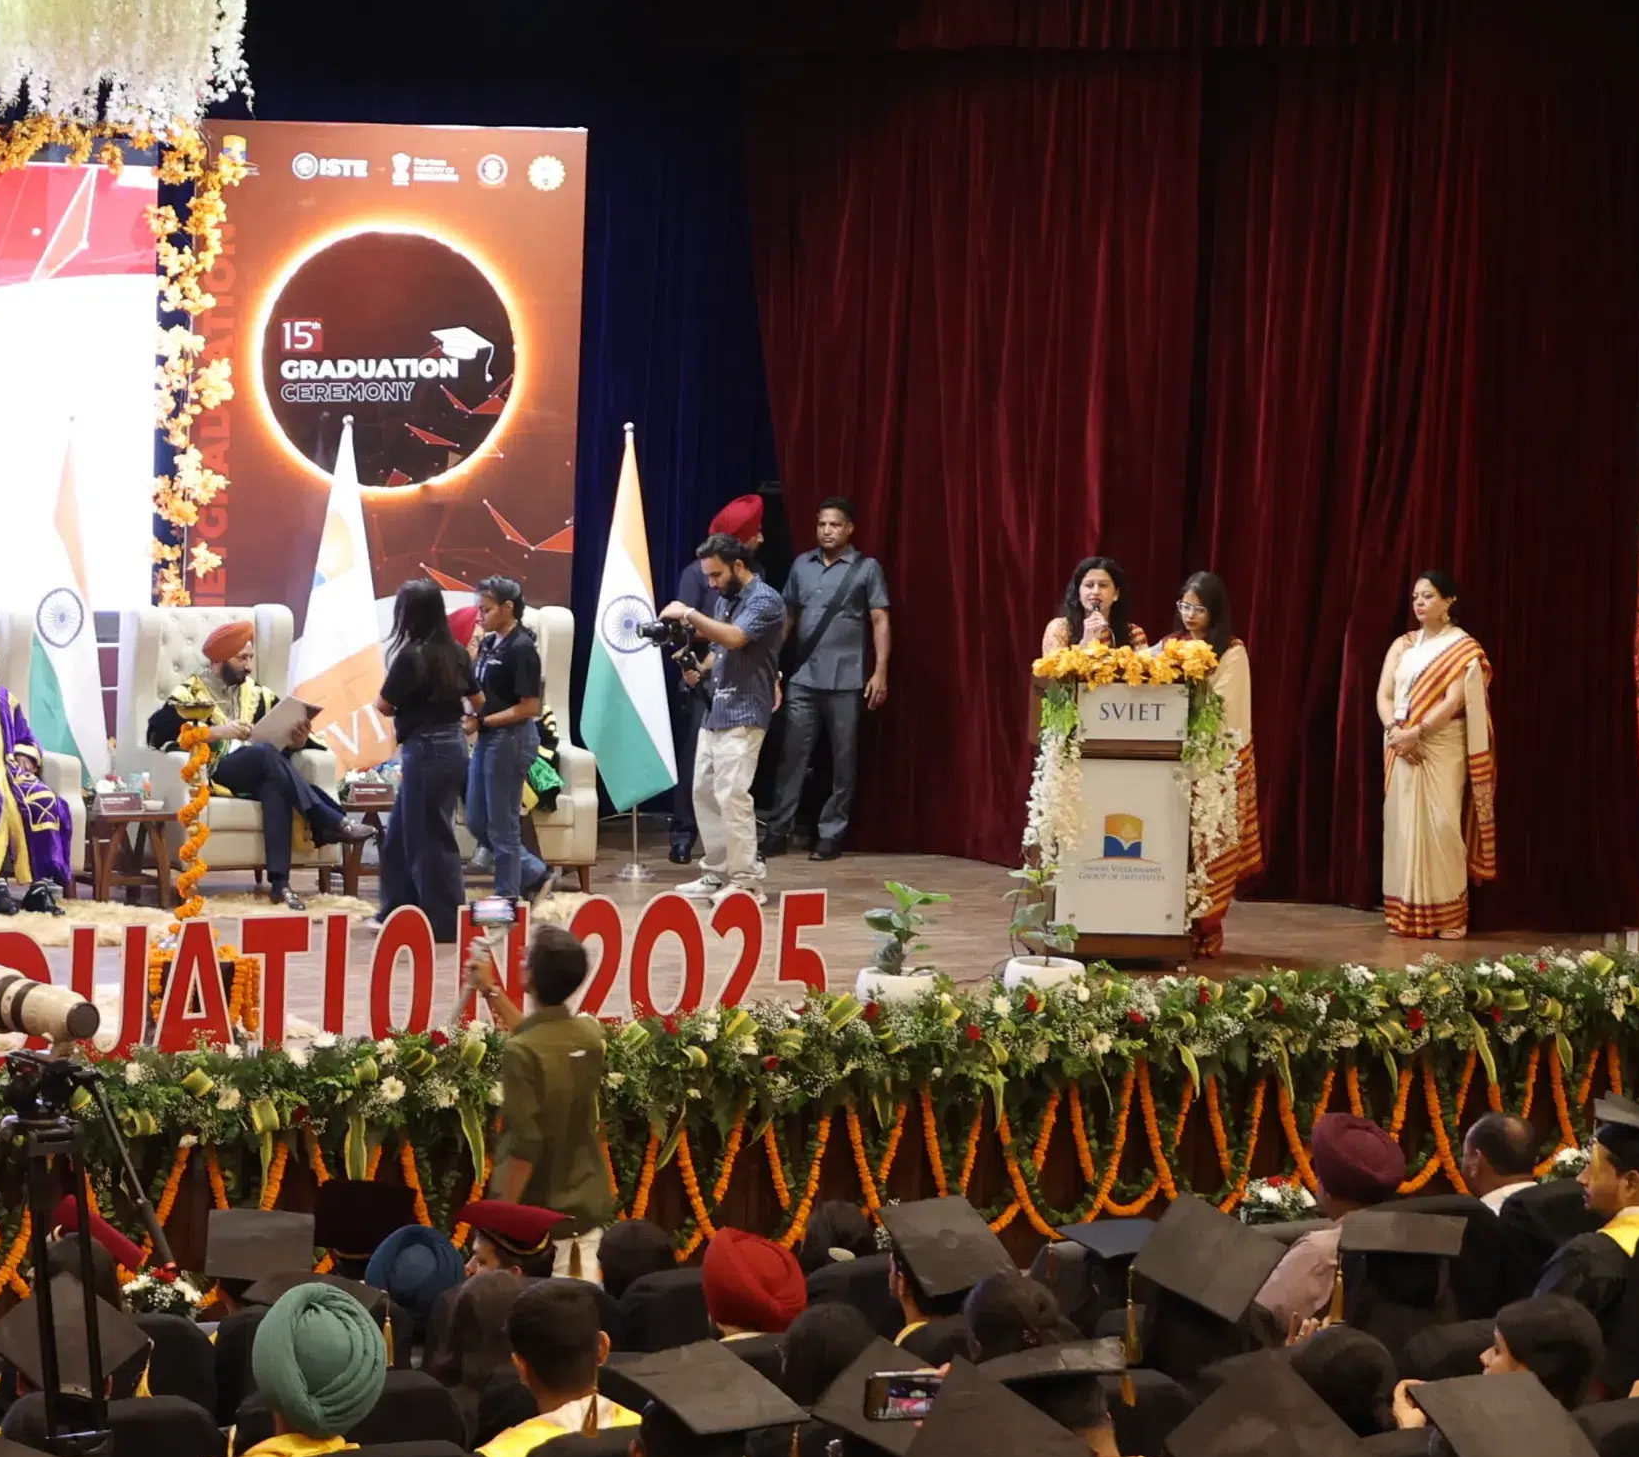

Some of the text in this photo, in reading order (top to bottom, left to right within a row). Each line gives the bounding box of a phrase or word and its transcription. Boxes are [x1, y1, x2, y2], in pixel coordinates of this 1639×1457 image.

[320, 158, 368, 178] ISTE
[280, 358, 459, 380] GRADUATION
[281, 381, 416, 403] CEREMONY
[1099, 702, 1166, 722] SVIET
[565, 888, 828, 1022] 2025
